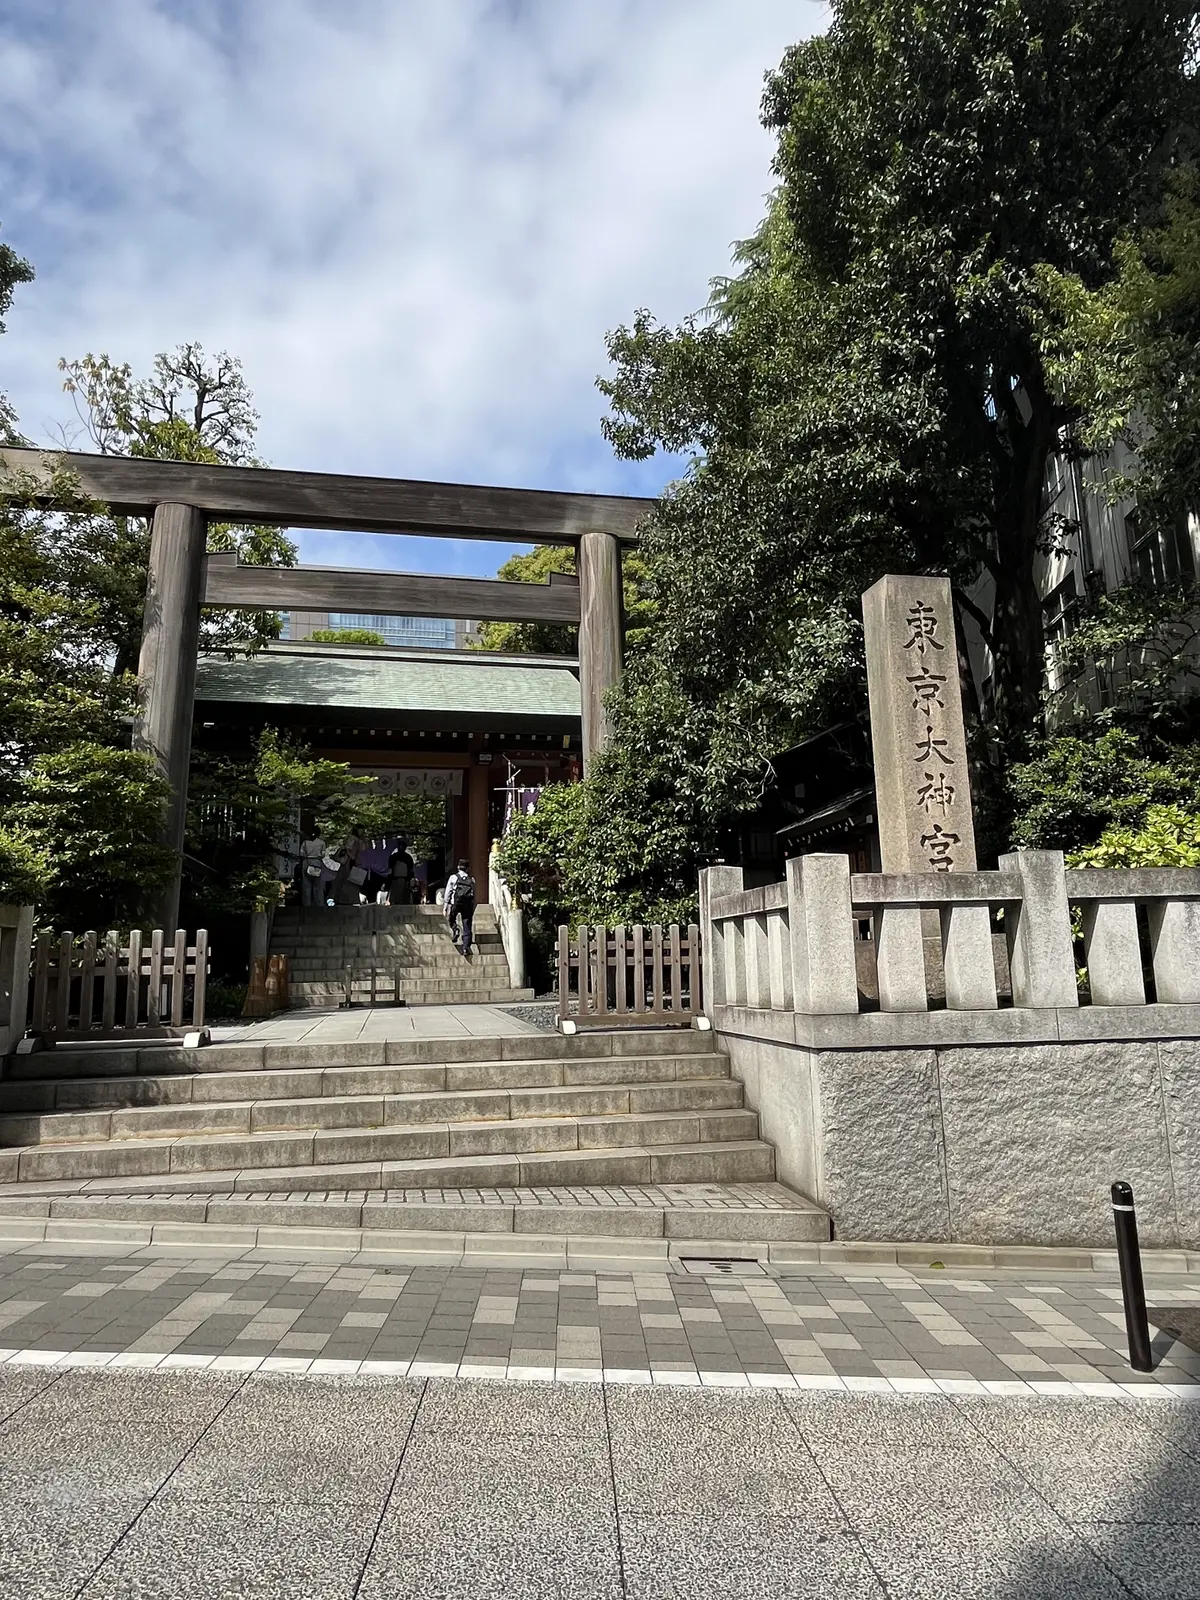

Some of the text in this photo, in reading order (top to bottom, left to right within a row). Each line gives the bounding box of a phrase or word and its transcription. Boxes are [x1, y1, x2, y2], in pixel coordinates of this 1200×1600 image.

[903, 600, 960, 873] 東京大神宮
